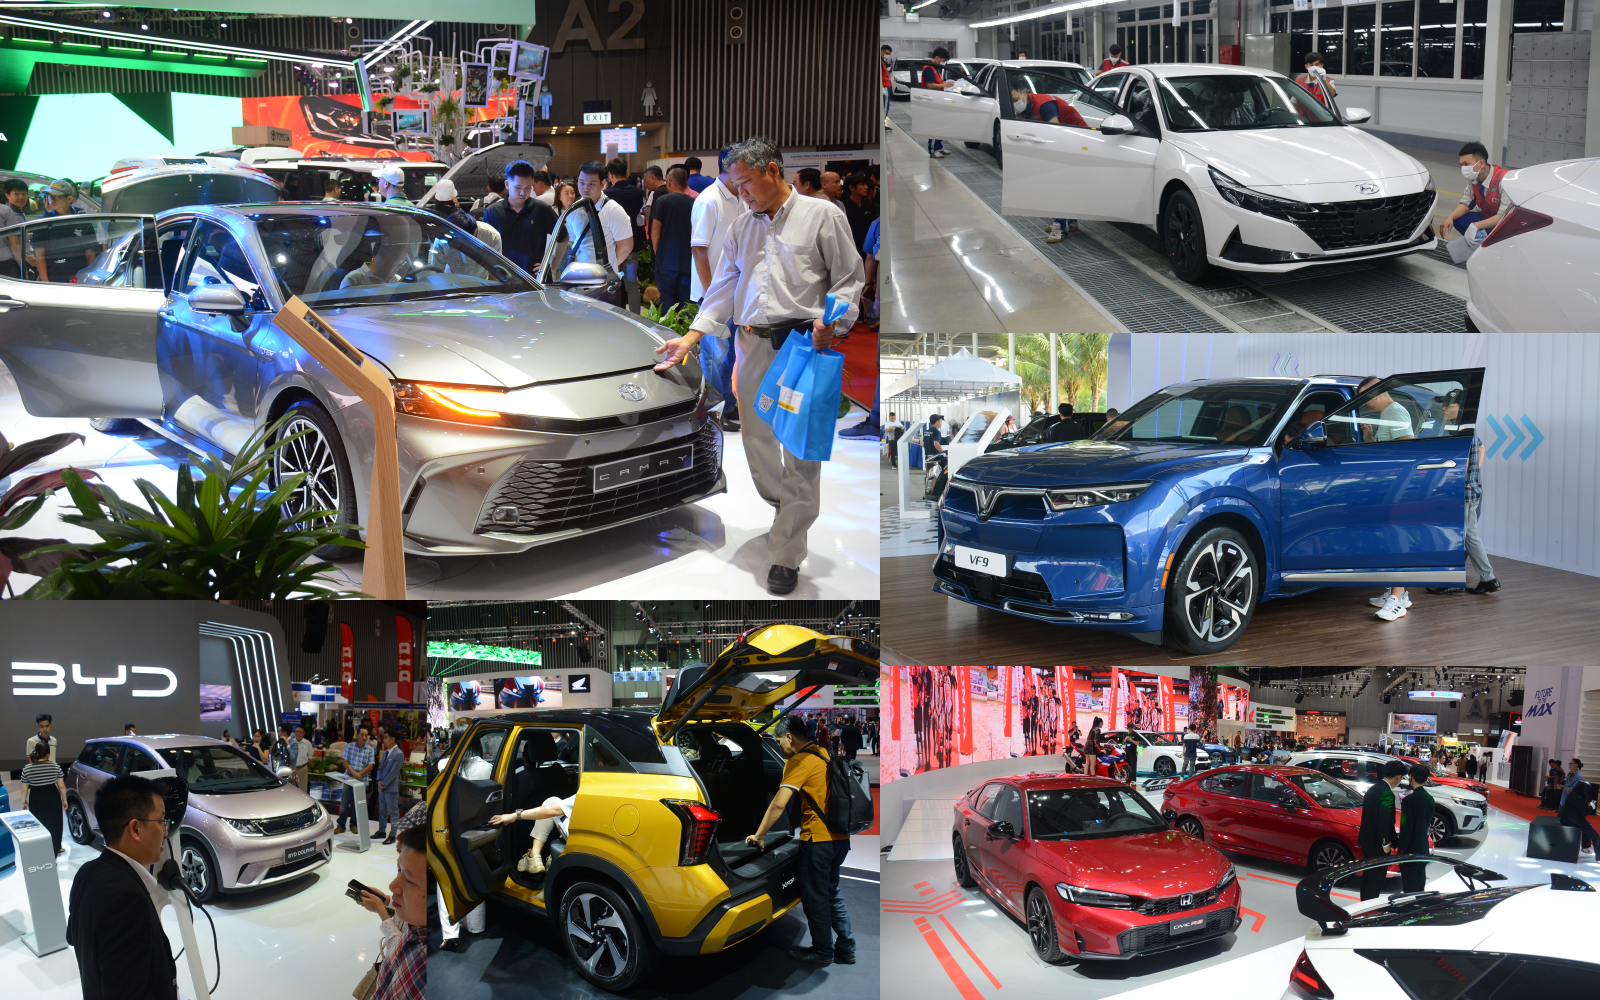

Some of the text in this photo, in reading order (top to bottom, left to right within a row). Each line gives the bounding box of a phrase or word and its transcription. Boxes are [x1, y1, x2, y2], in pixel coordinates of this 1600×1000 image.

[550, 0, 645, 53] A2
[599, 455, 687, 481] CAMRY
[970, 554, 989, 567] VF9
[11, 661, 178, 697] BYD
[1525, 701, 1556, 718] MAX
[297, 846, 315, 856] DOLPHIN
[28, 862, 53, 874] BYD
[1173, 922, 1190, 930] CIVIC
